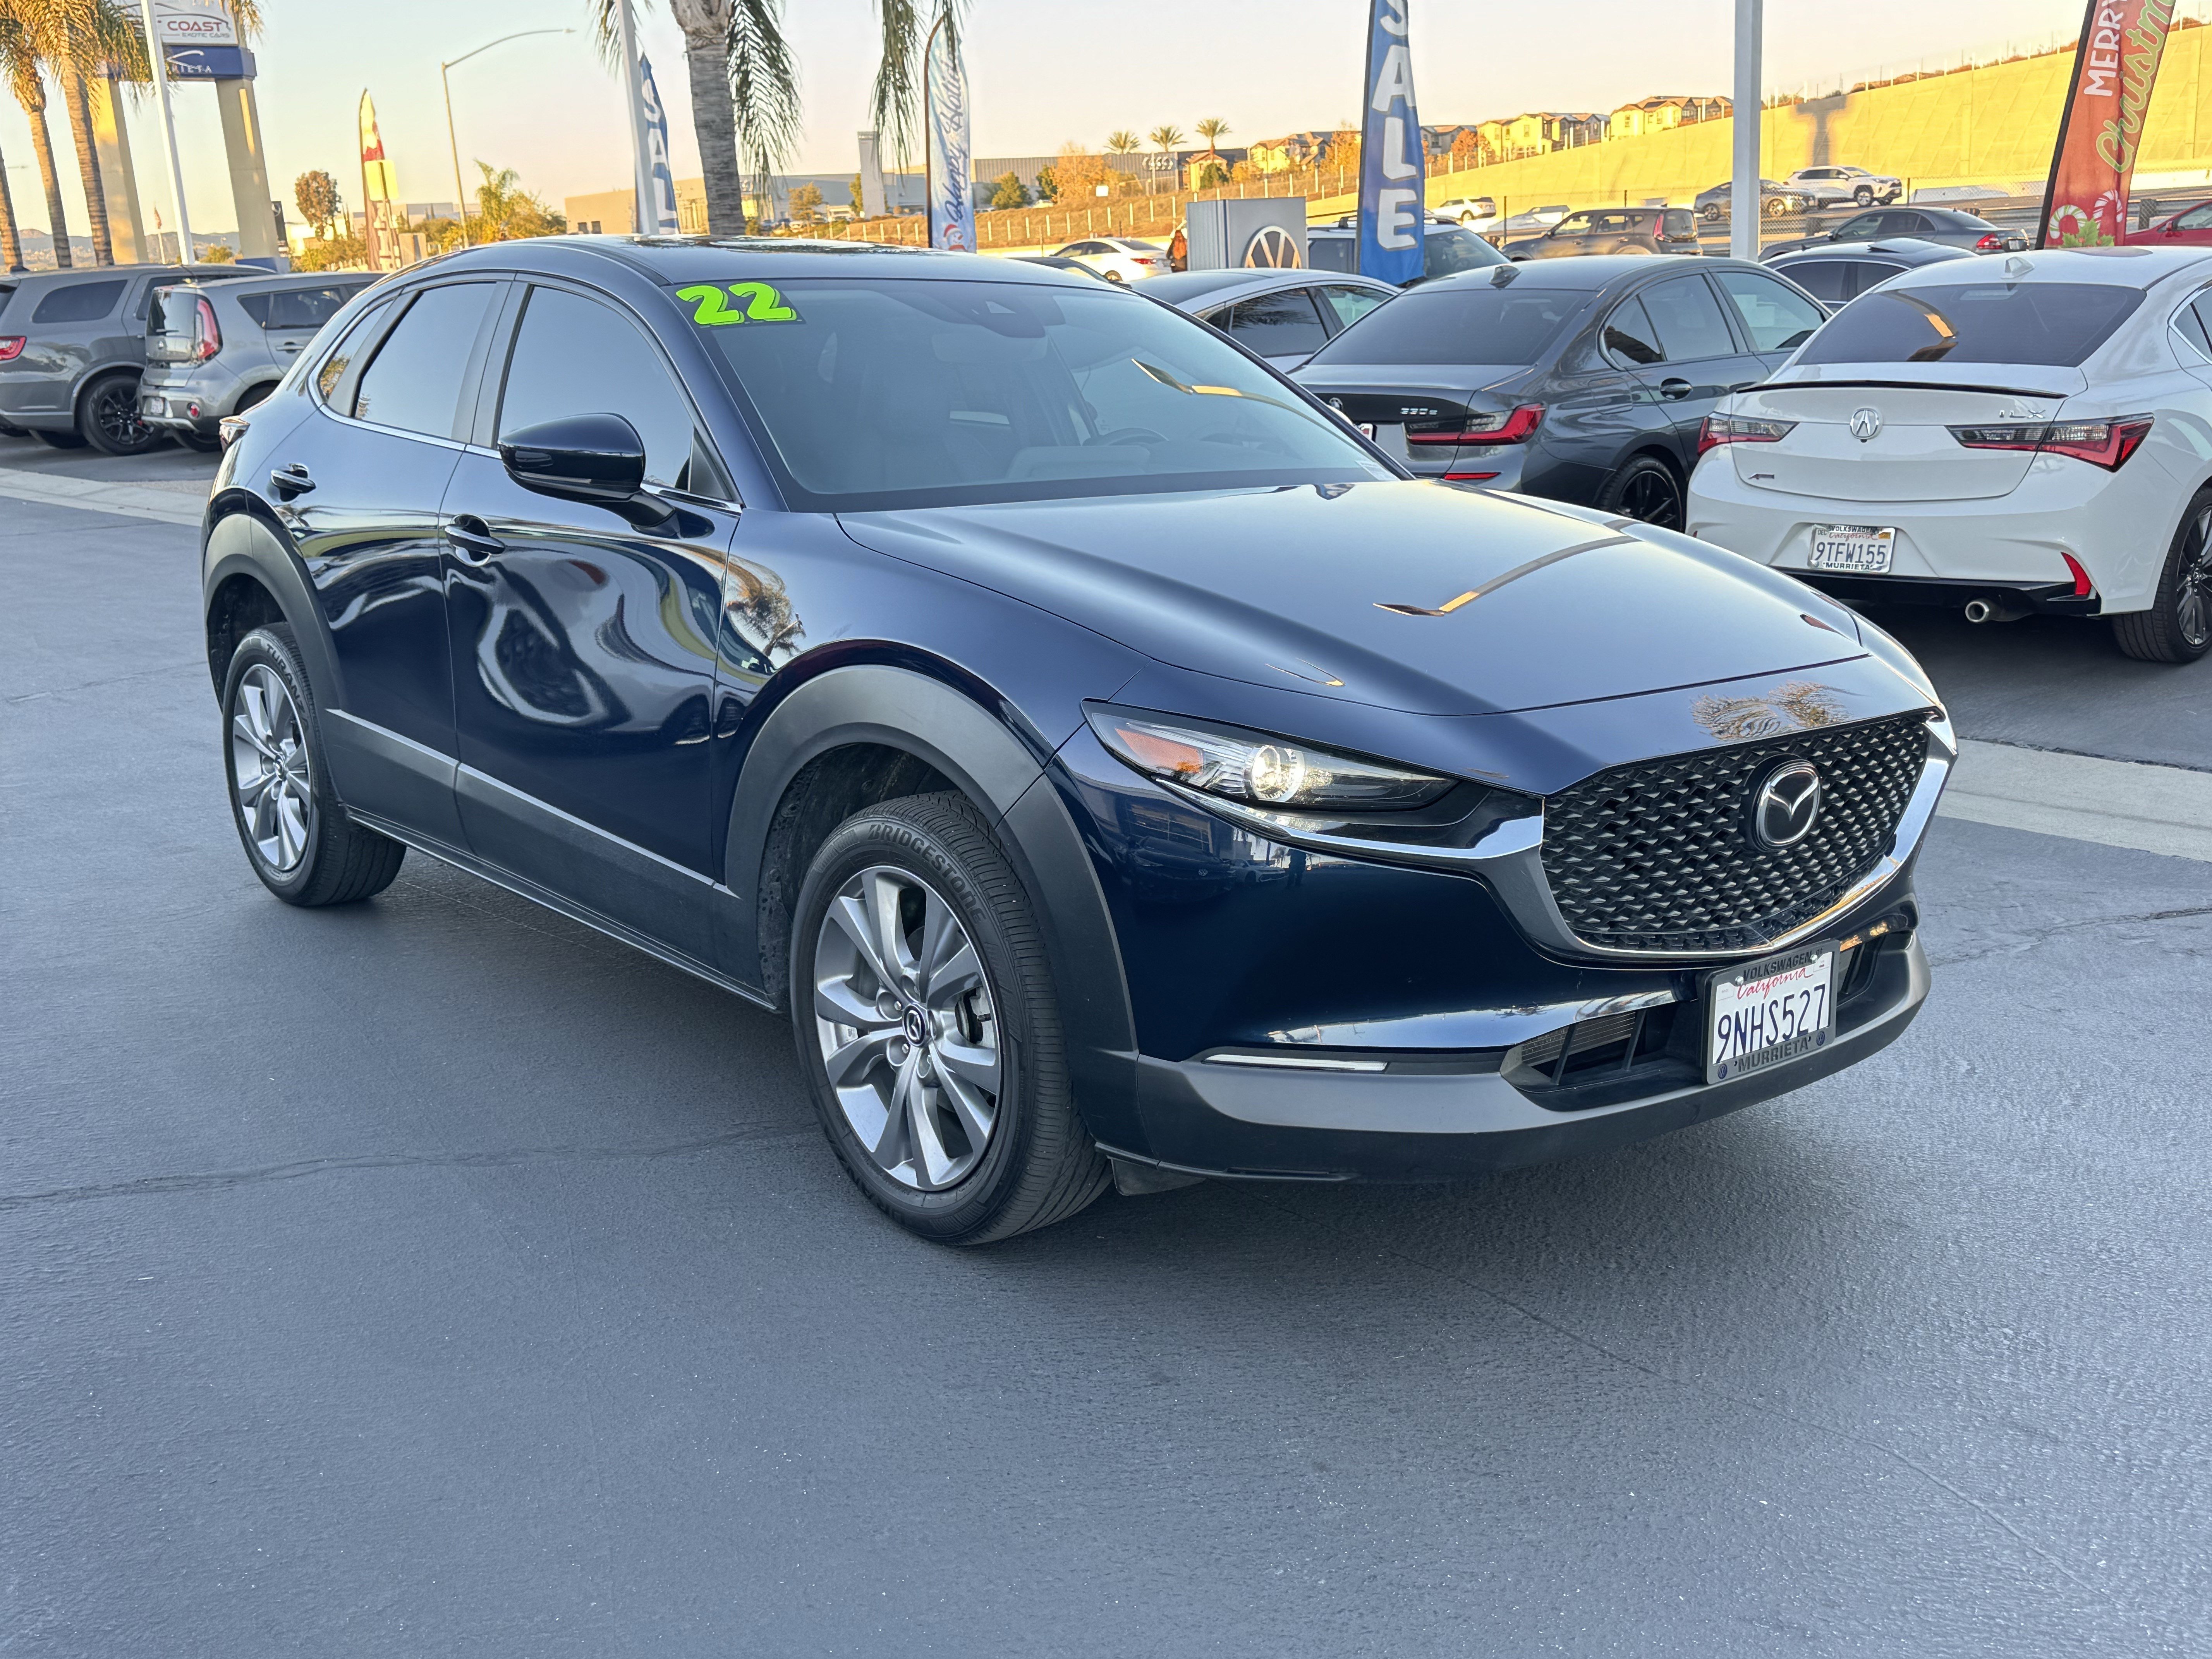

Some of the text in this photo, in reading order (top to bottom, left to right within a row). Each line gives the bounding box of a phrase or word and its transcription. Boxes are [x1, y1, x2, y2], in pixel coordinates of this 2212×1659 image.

[167, 21, 222, 32] COAST
[642, 79, 678, 234] SAL
[943, 142, 968, 223] Happy
[676, 282, 797, 326] 22
[1999, 410, 2046, 419] ILX
[1815, 541, 1886, 565] 9TFW155
[1829, 532, 1878, 541] California
[1826, 562, 1870, 570] MURRIETA
[868, 824, 989, 924] BRIDGESTONE
[1743, 950, 1813, 981] VOLKSWAGEN
[1737, 967, 1814, 1000] California
[1716, 983, 1826, 1064] 9NHS527
[1738, 1037, 1808, 1072] MURRIETA
